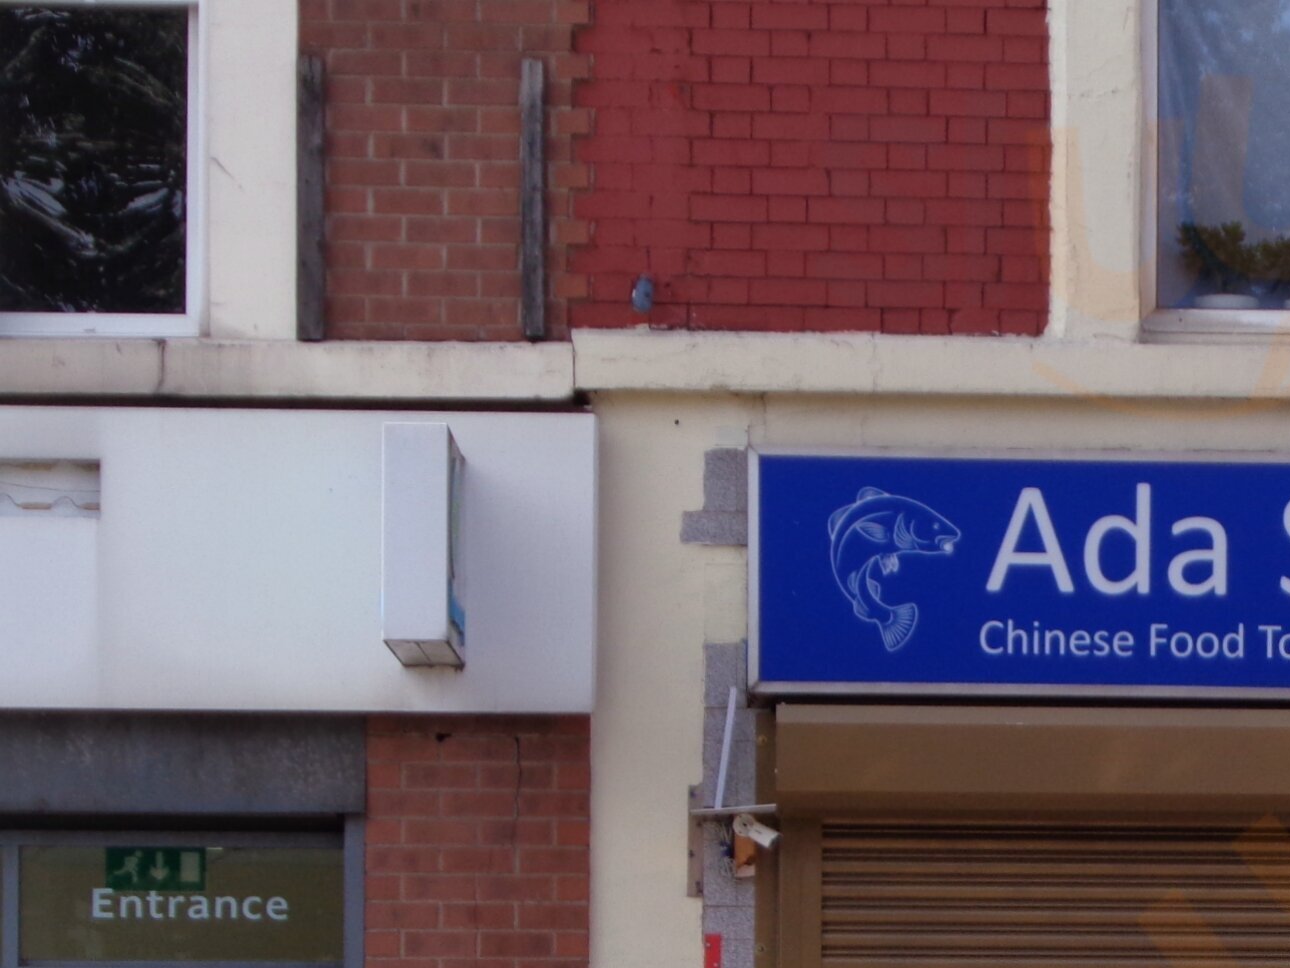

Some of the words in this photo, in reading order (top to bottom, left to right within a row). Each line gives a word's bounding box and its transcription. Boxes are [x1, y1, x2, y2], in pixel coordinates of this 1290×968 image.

[987, 483, 1229, 597] Ada
[979, 620, 1134, 657] Chinese
[1150, 623, 1244, 659] Food
[92, 888, 288, 920] Entrance
